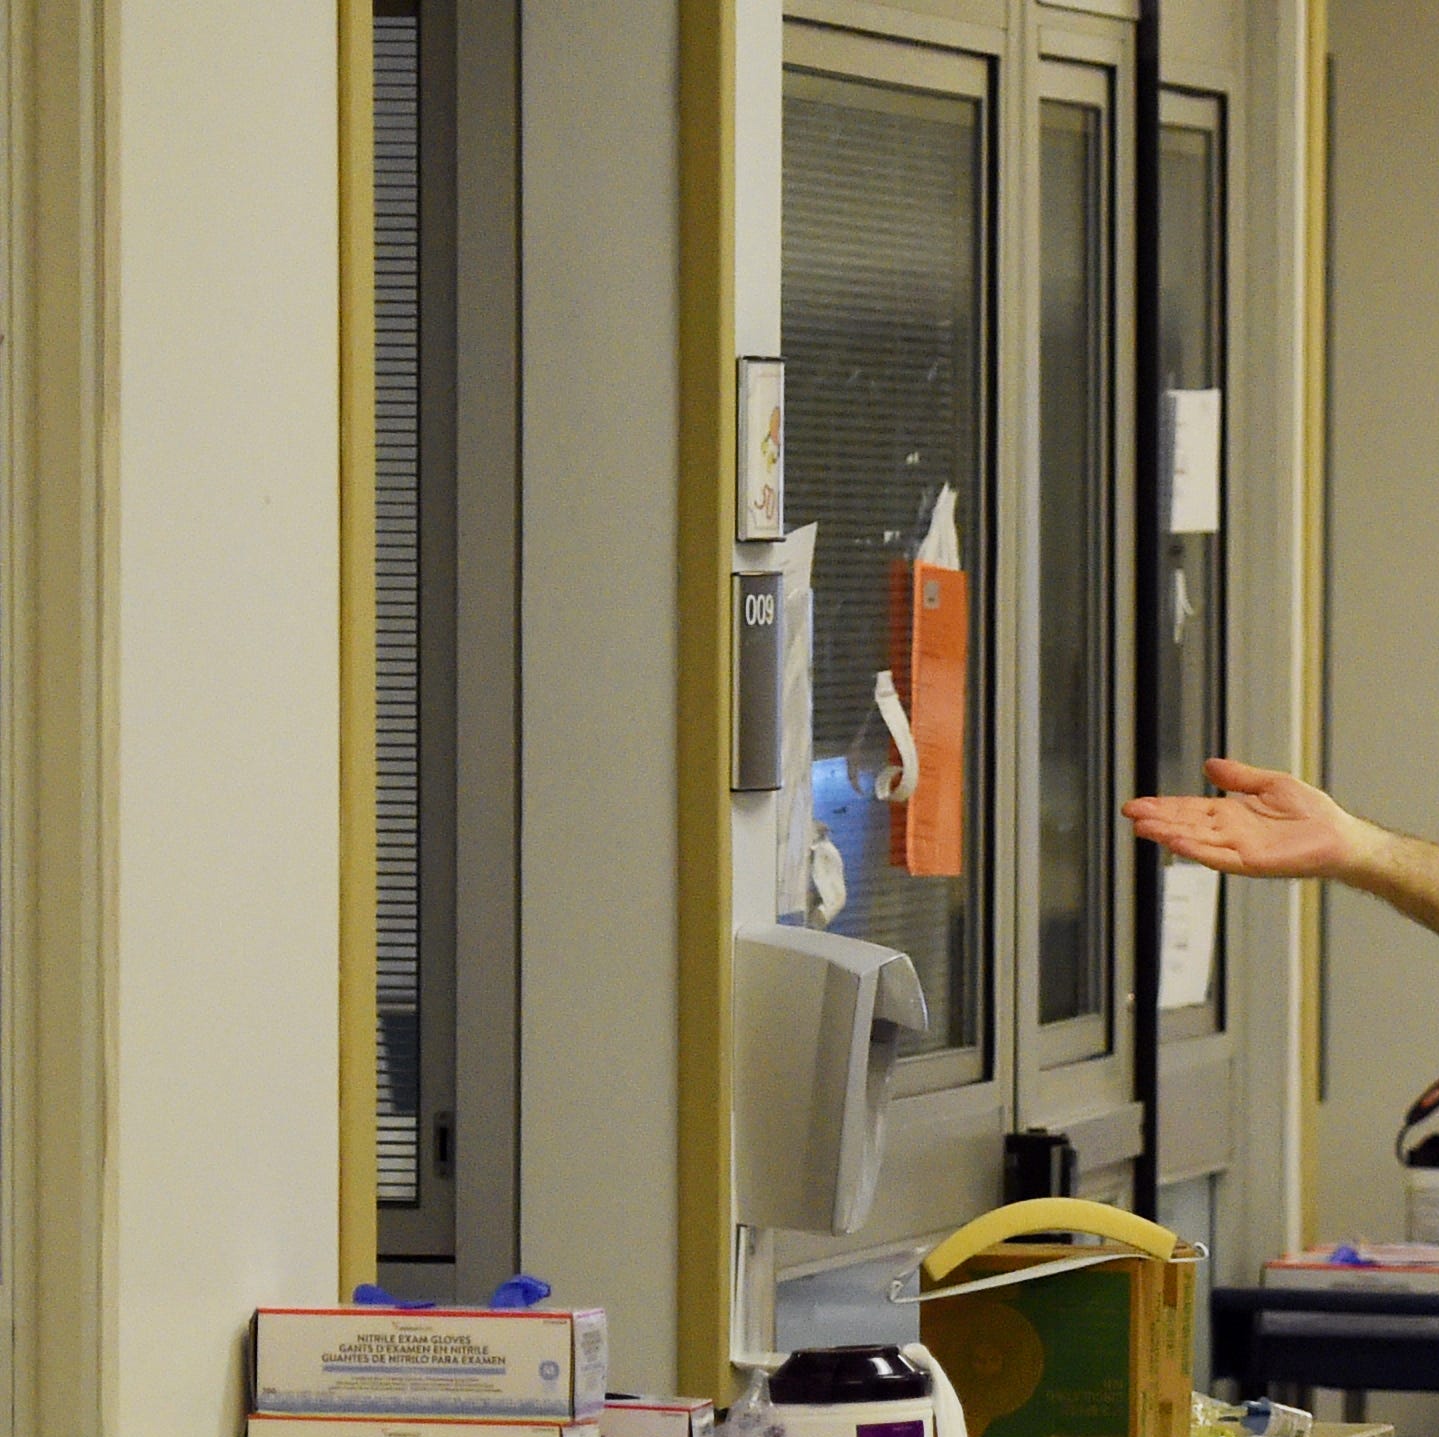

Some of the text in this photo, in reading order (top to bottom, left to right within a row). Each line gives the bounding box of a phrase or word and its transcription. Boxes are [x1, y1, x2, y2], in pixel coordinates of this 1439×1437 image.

[745, 594, 774, 625] 009
[357, 1334, 471, 1344] NITRILE EXAM GLOVES
[338, 1344, 373, 1353] GANTS
[433, 1345, 448, 1354] EN
[450, 1345, 489, 1355] NITRILE
[321, 1353, 506, 1365] GUANTES DE NITRILO PARA EXAMEN
